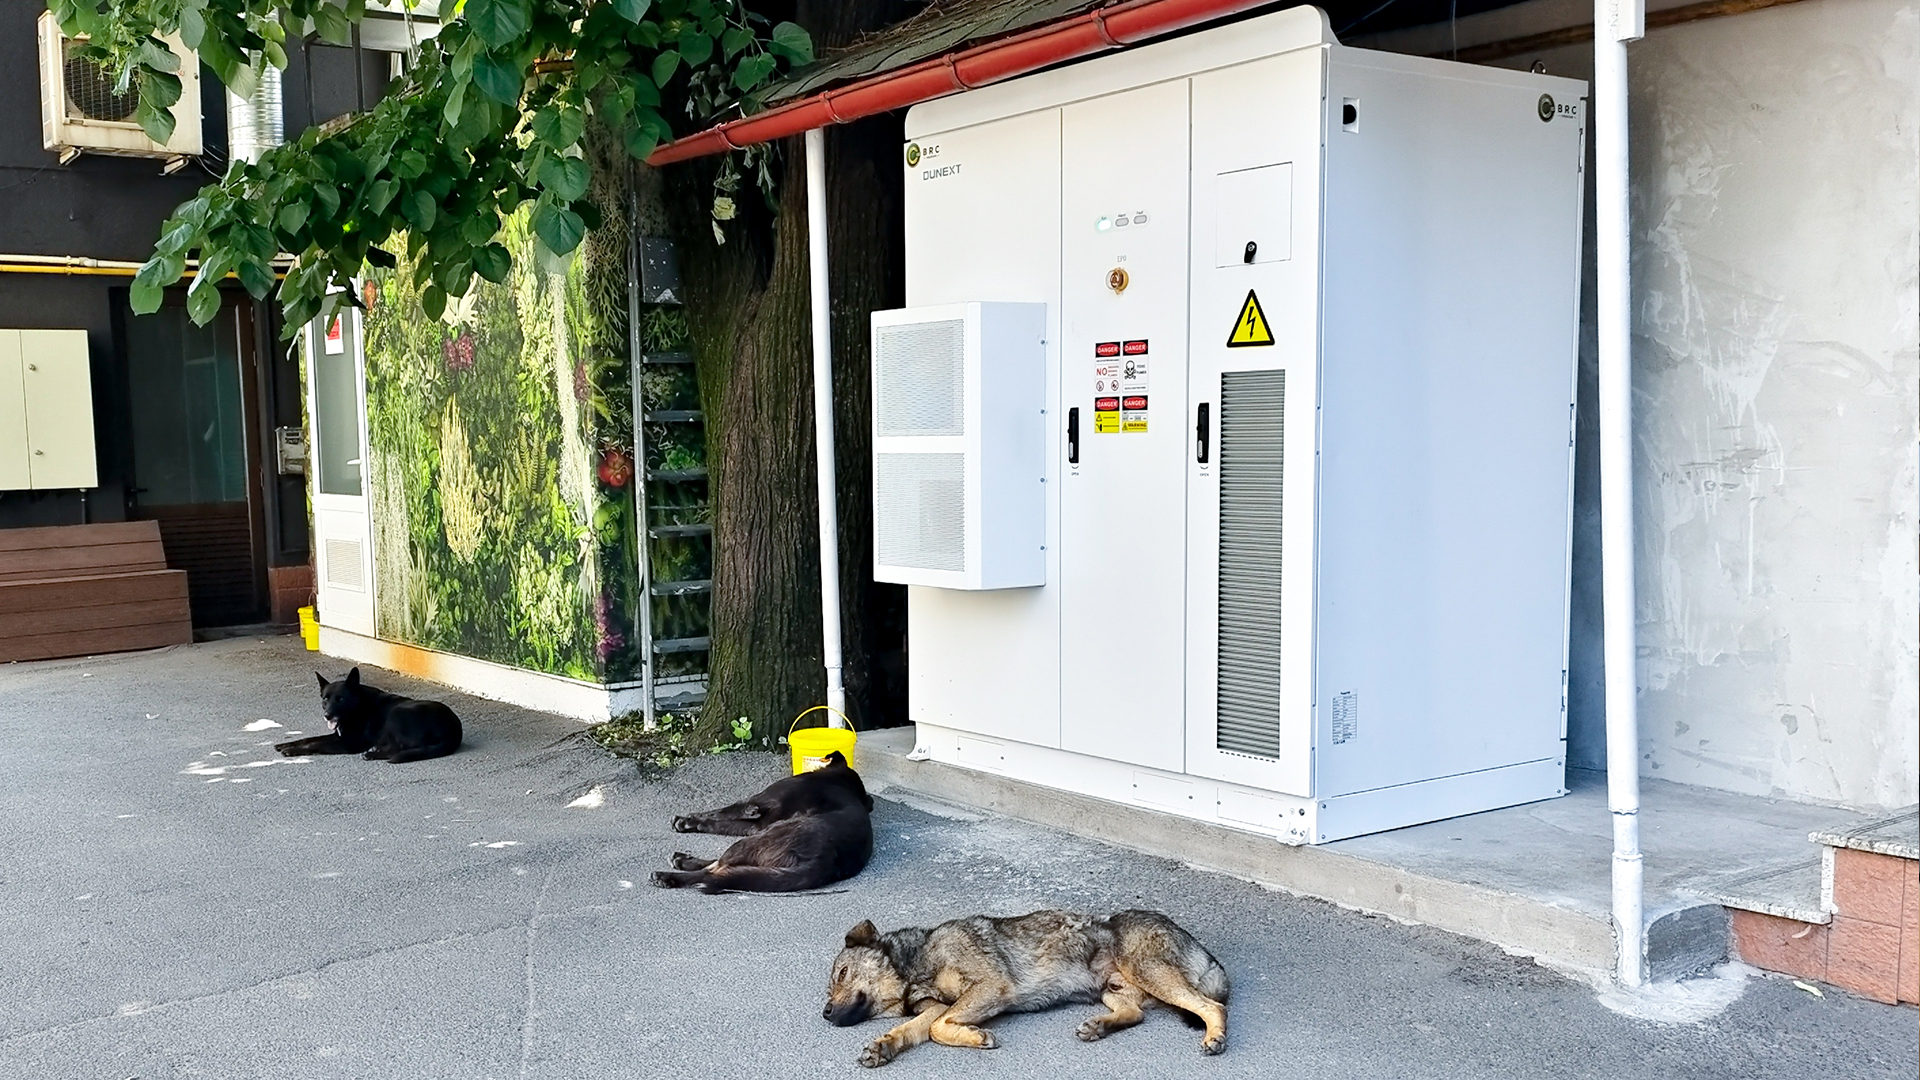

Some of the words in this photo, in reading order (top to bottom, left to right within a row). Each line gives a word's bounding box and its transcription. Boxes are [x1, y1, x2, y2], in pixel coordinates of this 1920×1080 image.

[1557, 103, 1577, 115] BRC
[922, 145, 940, 156] BRC
[923, 163, 962, 181] DUNEXT
[1097, 346, 1119, 354] DANGER
[1124, 343, 1146, 352] DANGER
[1096, 367, 1107, 376] NO
[1097, 400, 1118, 408] DANGER
[1124, 399, 1146, 407] DANGER
